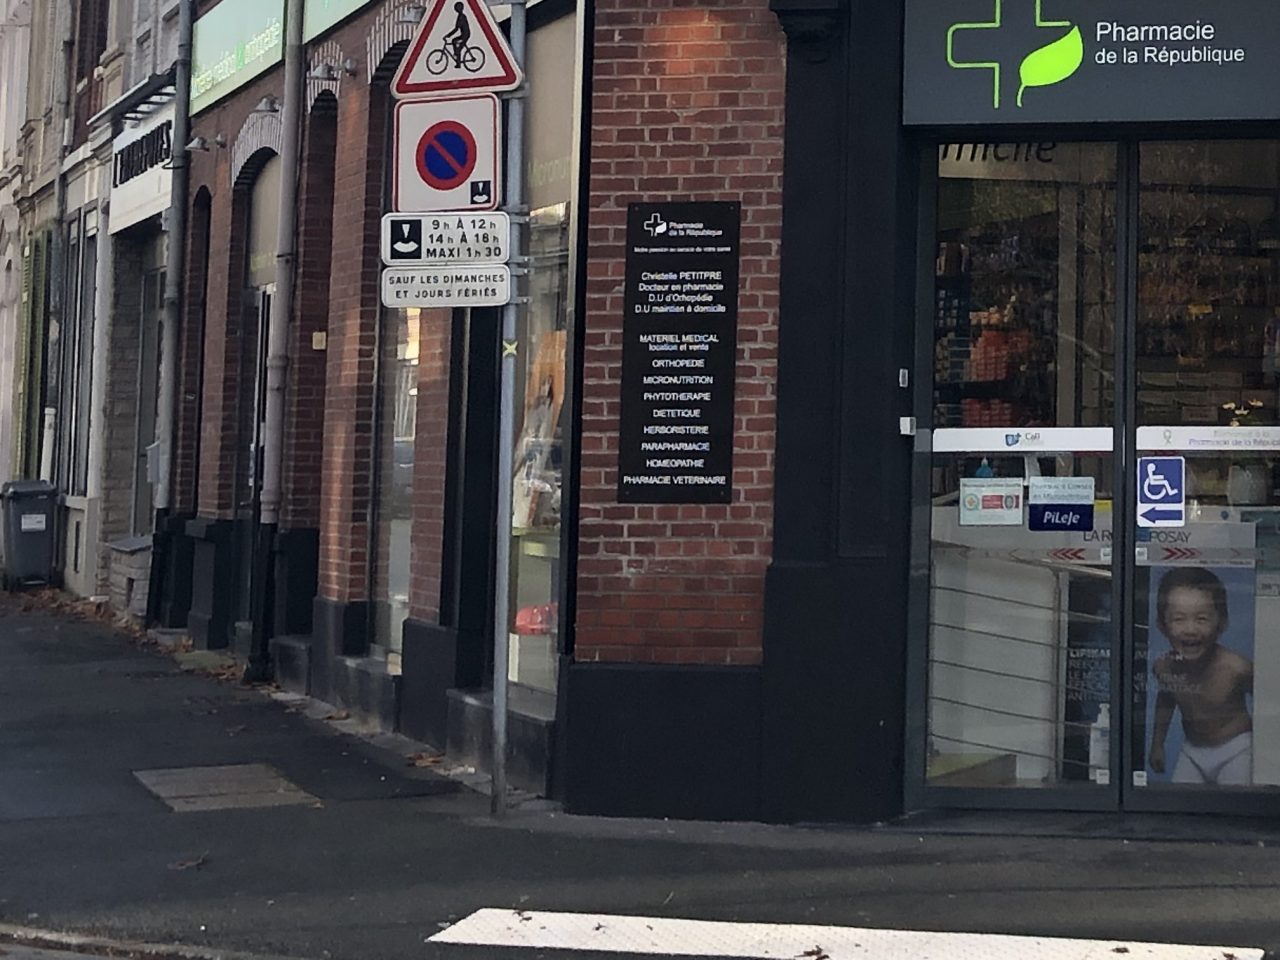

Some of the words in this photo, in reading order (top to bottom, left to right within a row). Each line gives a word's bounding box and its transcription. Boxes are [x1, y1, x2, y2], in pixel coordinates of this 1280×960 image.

[1096, 20, 1215, 42] Pharmacie
[1095, 48, 1117, 64] de
[1123, 48, 1138, 63] la
[1144, 45, 1245, 66] République
[426, 247, 460, 258] MAXI
[389, 276, 416, 284] SAUF
[420, 276, 439, 284] LES
[443, 274, 505, 284] DIMANCHES
[639, 283, 669, 291] Docteur
[683, 283, 724, 292] pharmacie
[395, 291, 408, 299] ET
[415, 290, 452, 299] JOURS
[457, 287, 497, 298] FÉRIÉS
[640, 334, 680, 342] MATERIEL
[681, 334, 719, 342] MEDICAL
[652, 359, 705, 368] ORTHOPEDIE
[643, 376, 714, 384] MICRONUTRITION
[643, 392, 711, 401] PHYTOTHERAPIE
[653, 409, 701, 418] DIETETIQUE
[643, 426, 709, 434] HERBORISTERIE
[641, 442, 711, 451] PARAPHARMACIE
[646, 459, 705, 468] HOMEOPATHIE
[623, 476, 671, 484] PHARMACIE
[672, 476, 726, 484] VETERINAIRE
[1043, 511, 1081, 526] PiLeJe
